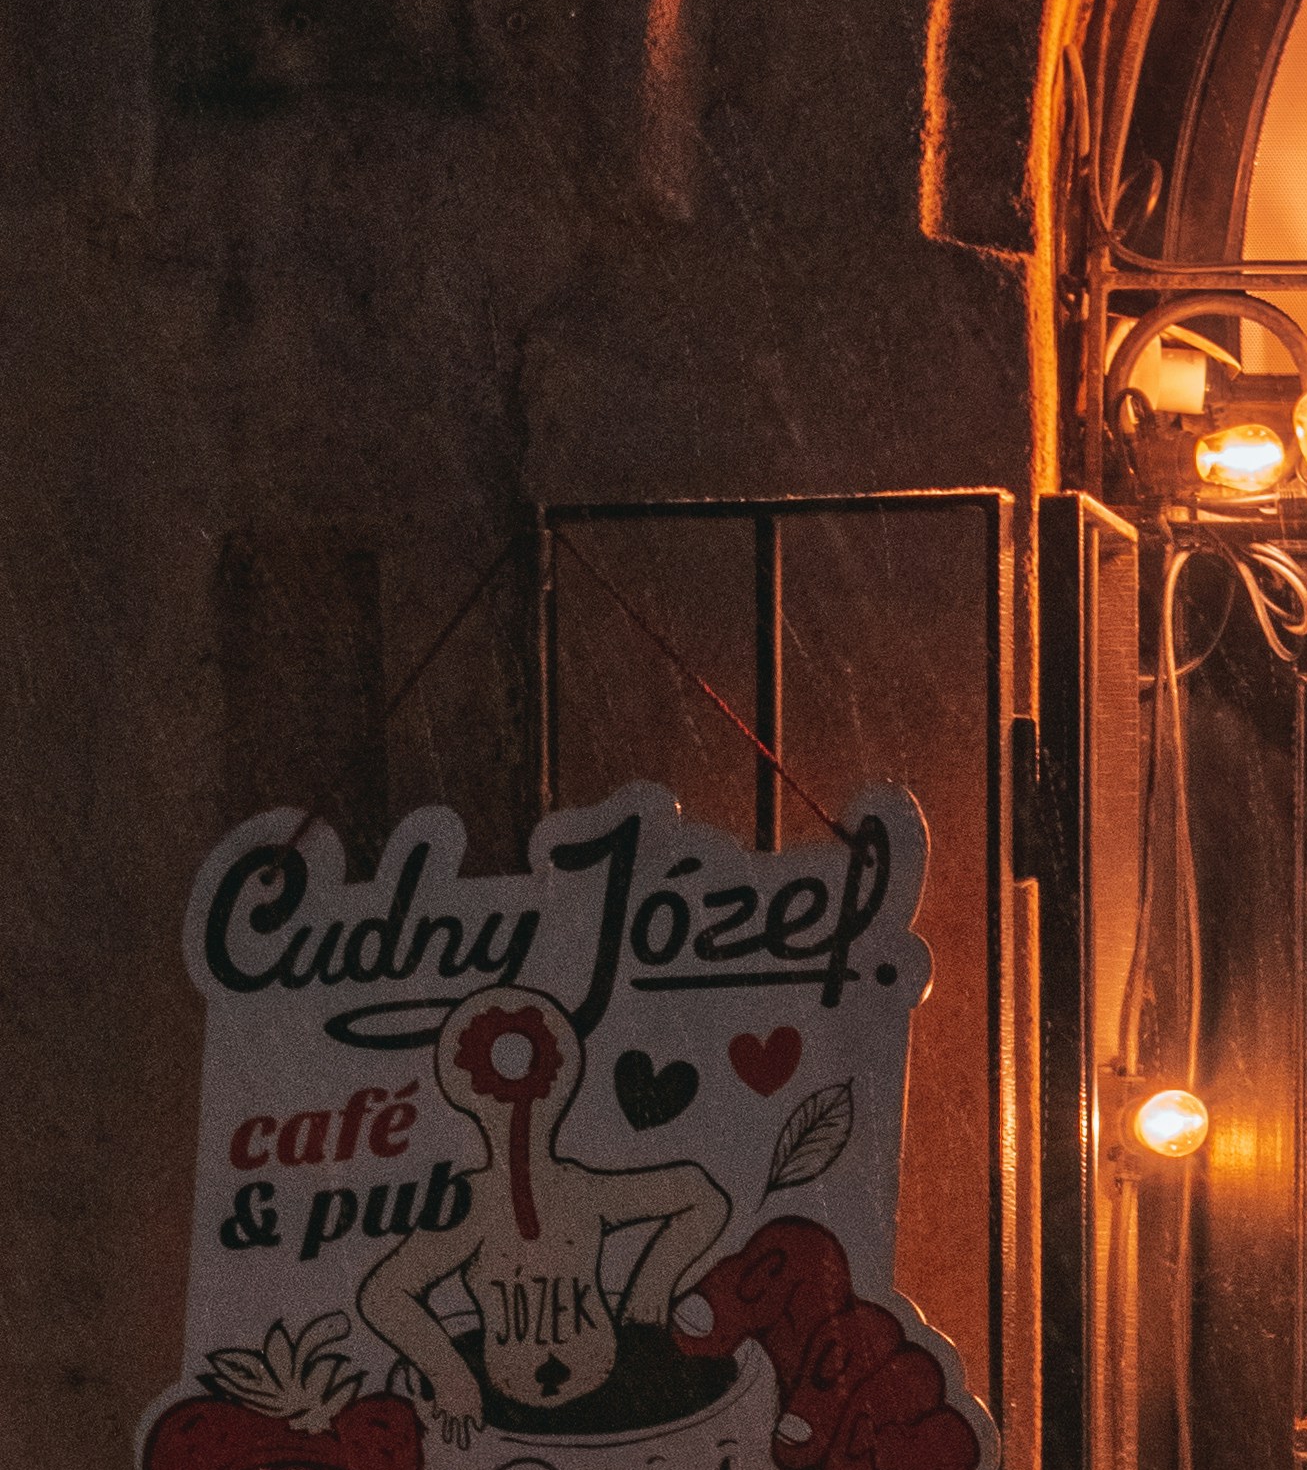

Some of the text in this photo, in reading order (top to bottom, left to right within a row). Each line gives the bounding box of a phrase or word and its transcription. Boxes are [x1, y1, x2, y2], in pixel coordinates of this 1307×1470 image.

[205, 843, 540, 1049] Cudny
[229, 1081, 421, 1171] café
[219, 1160, 473, 1261] & pub
[490, 1265, 598, 1346] JÓZEK
